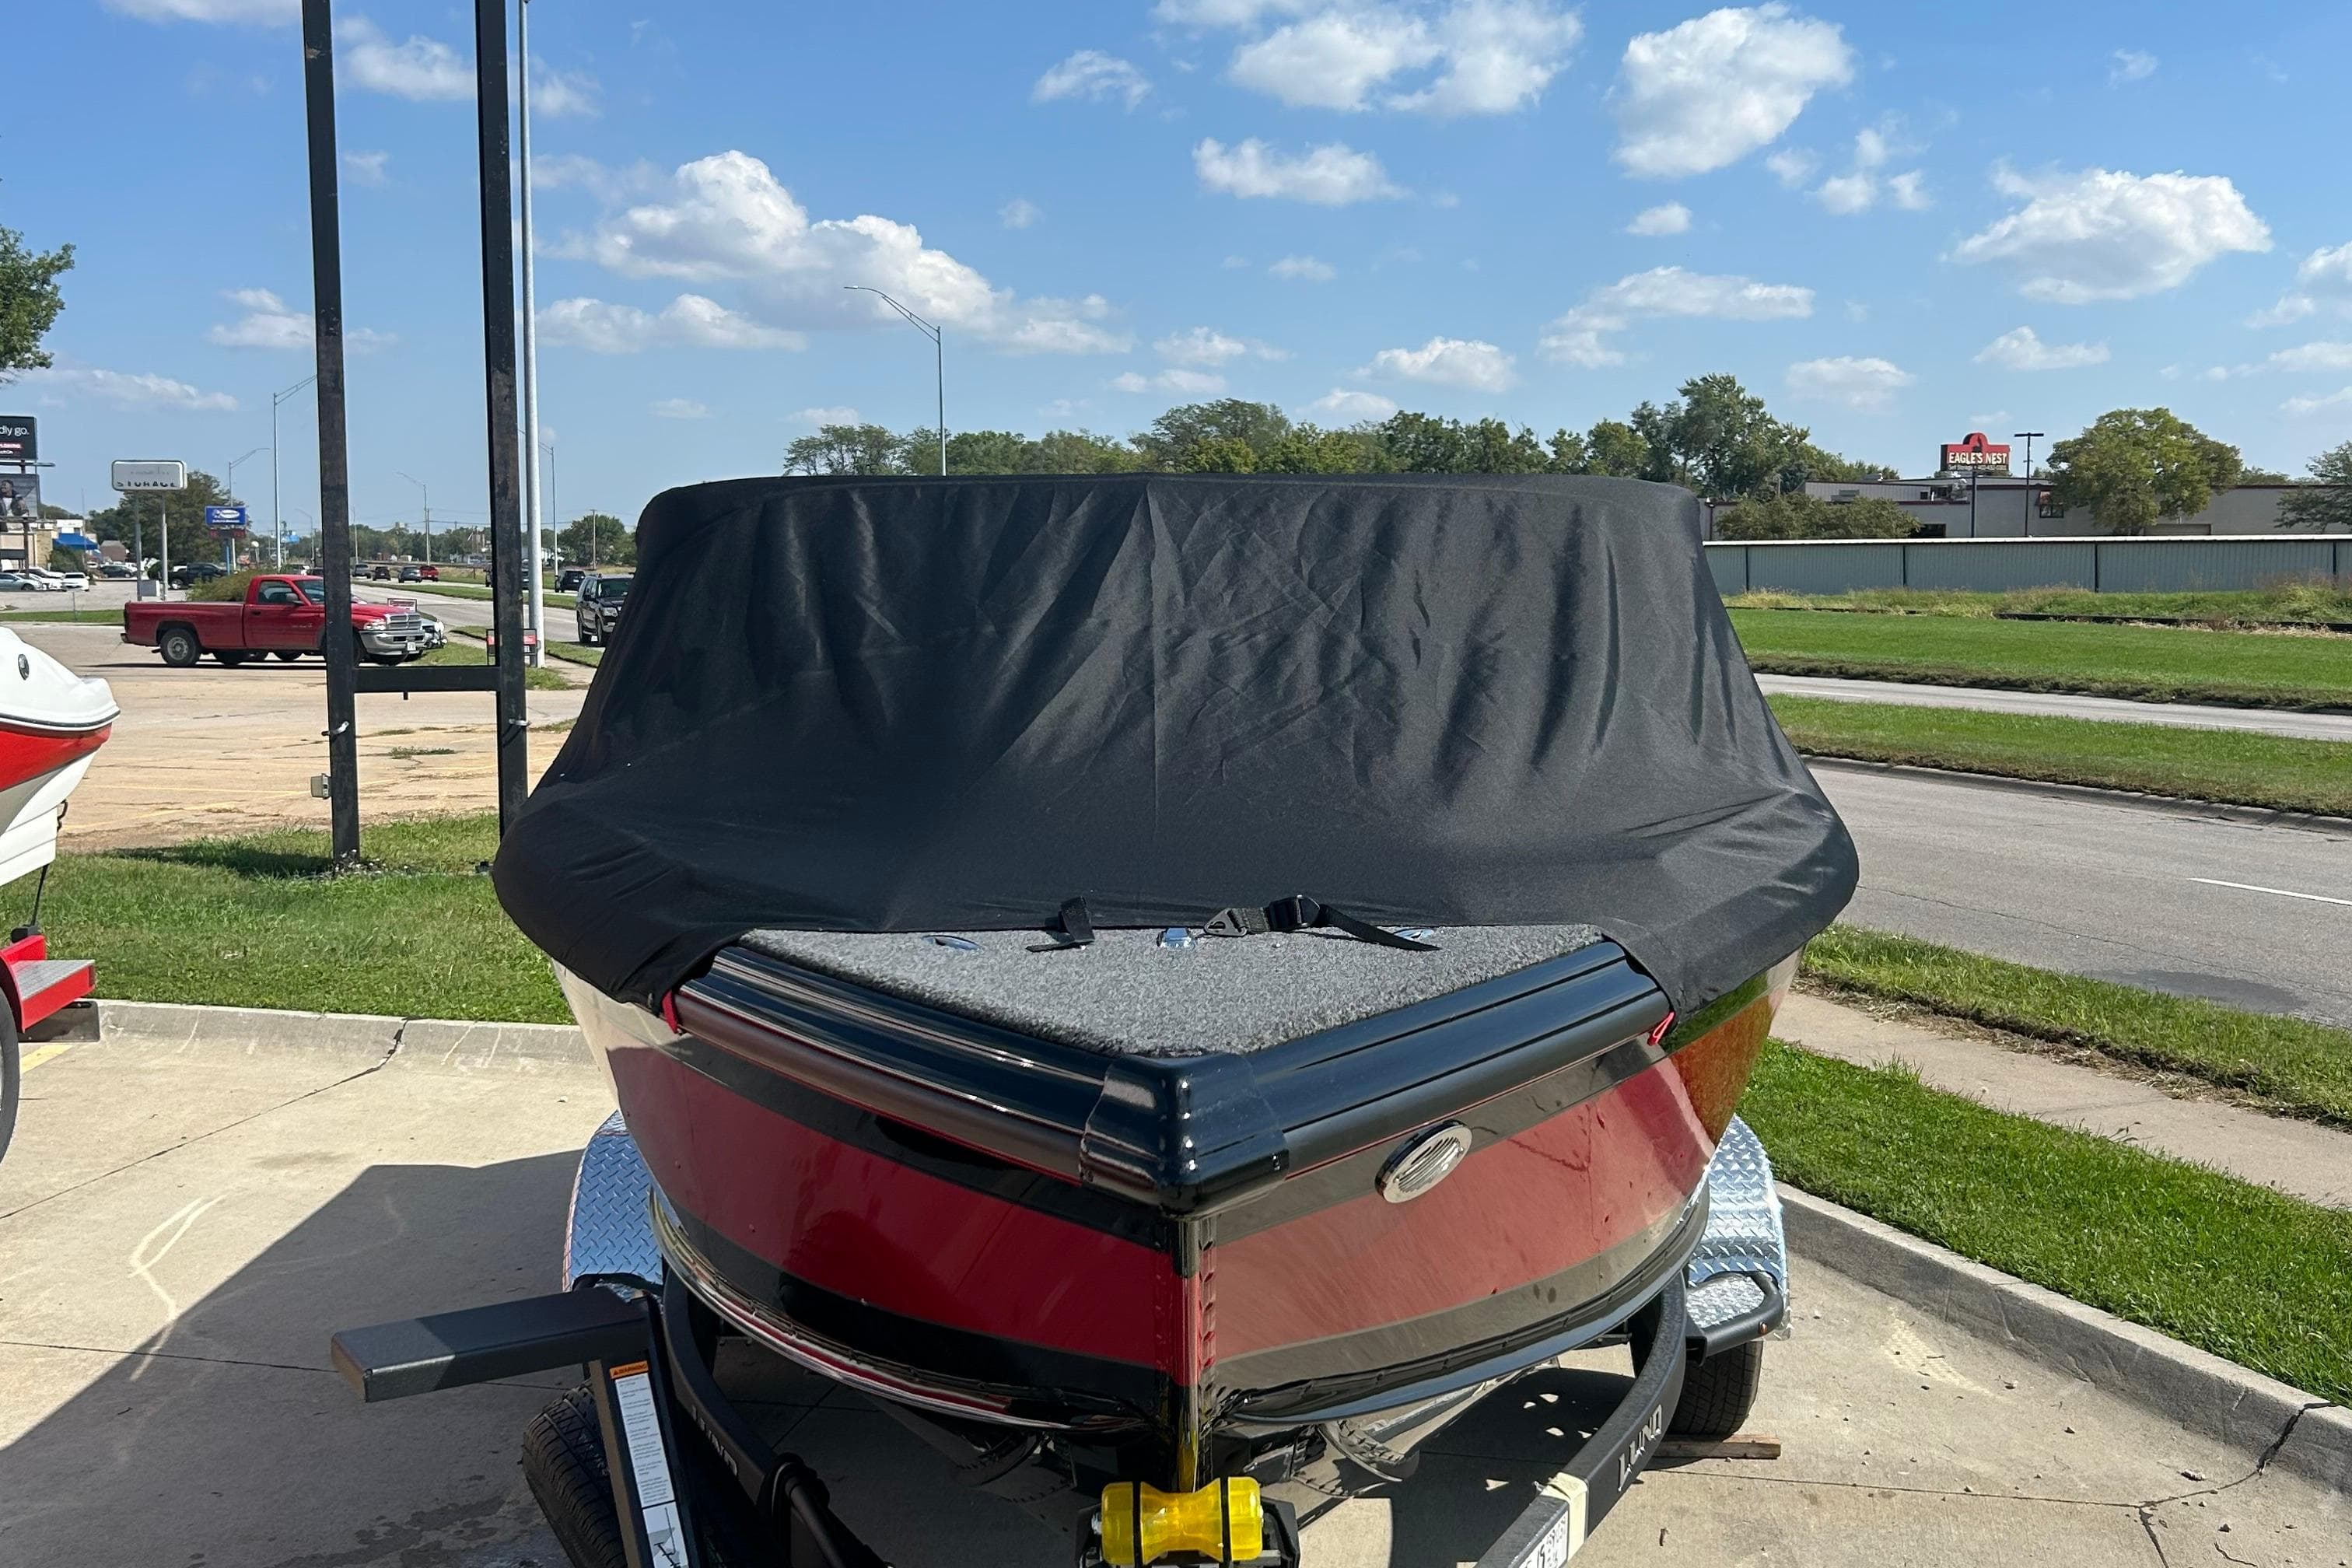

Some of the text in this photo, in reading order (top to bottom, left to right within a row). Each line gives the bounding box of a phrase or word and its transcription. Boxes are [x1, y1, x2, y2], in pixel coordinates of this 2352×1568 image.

[15, 427, 30, 436] go.
[1948, 452, 2007, 465] EAGLE'S NEST
[1618, 1404, 1662, 1492] LUND
